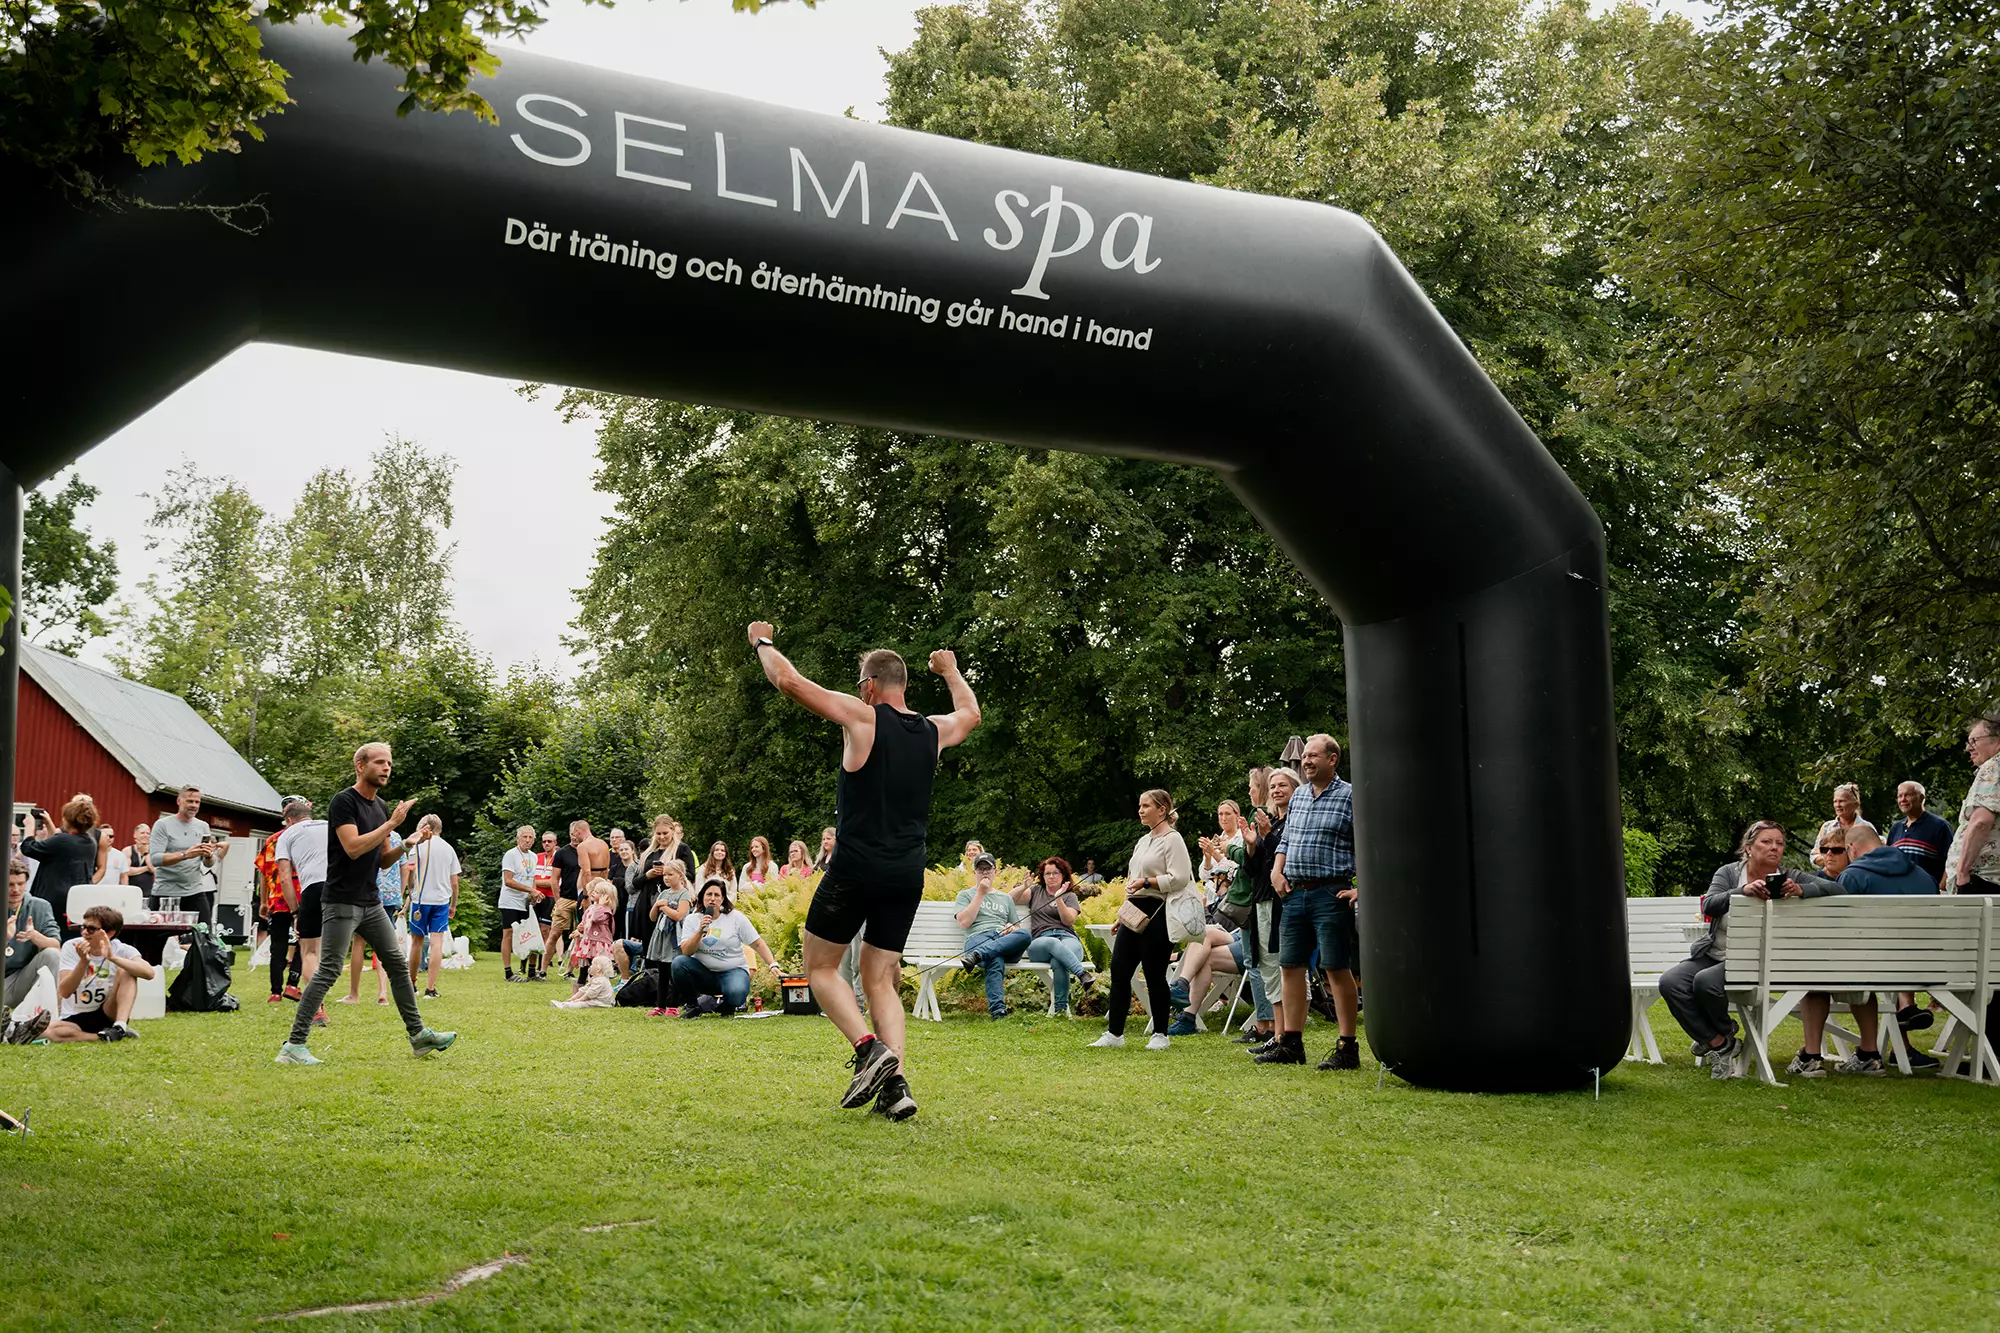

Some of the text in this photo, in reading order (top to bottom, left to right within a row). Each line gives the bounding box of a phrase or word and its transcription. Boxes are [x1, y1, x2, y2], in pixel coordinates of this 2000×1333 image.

[509, 93, 1162, 300] SELMA spa
[504, 217, 1154, 351] Där träning och återhämtning går hand i hand
[980, 901, 1004, 913] OCUS
